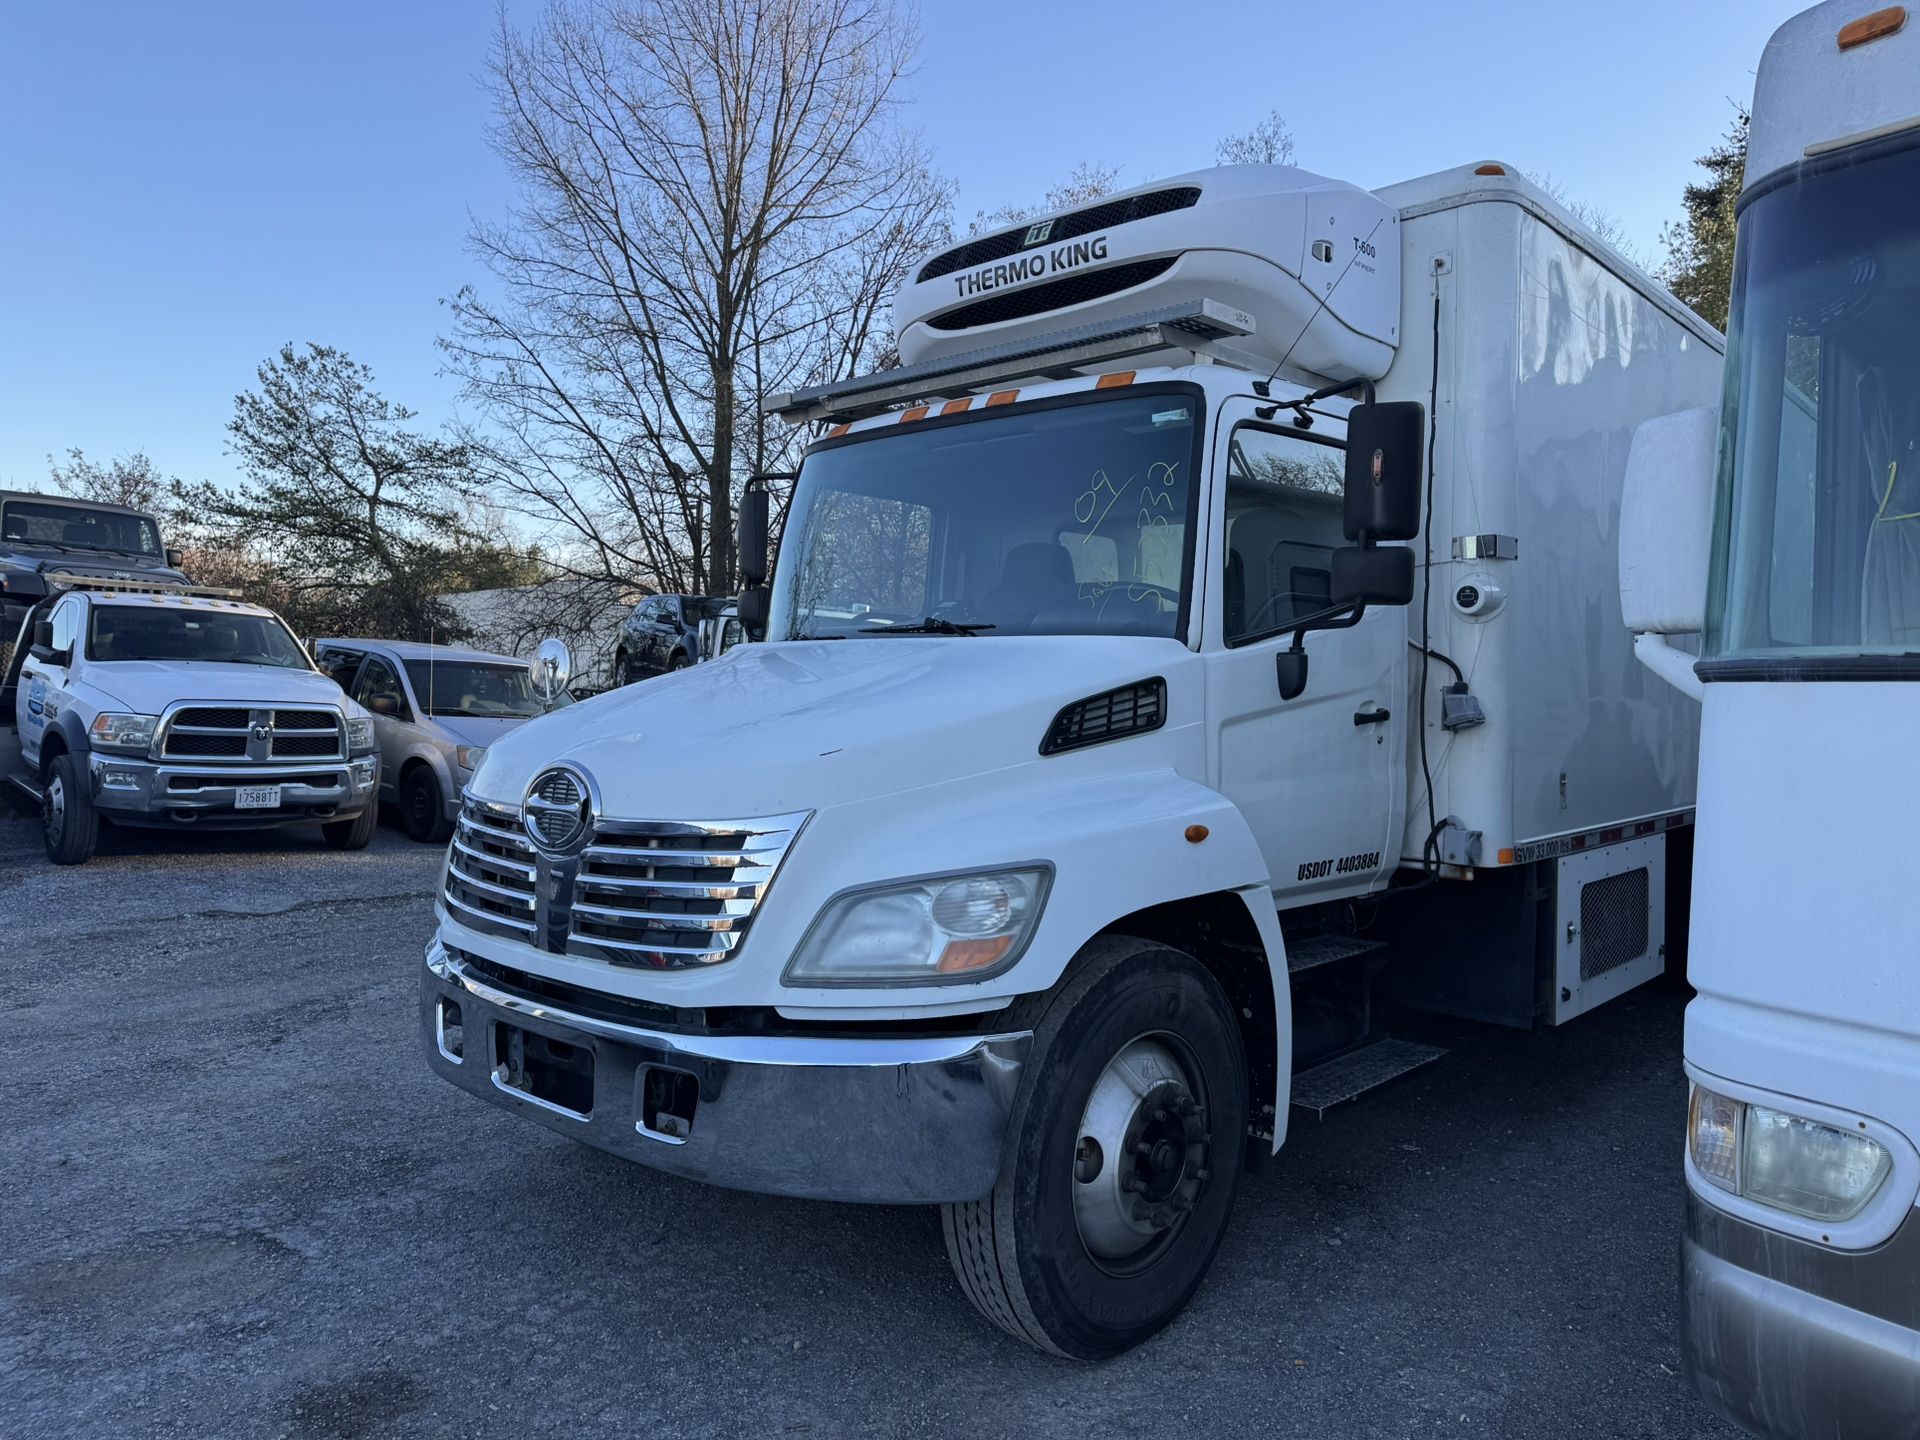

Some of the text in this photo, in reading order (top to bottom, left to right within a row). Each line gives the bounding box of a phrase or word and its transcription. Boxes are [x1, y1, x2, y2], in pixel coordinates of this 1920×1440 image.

[1353, 236, 1376, 259] T-600
[954, 236, 1108, 297] THERMO KING
[1297, 851, 1380, 881] USDOT 4403884
[1515, 844, 1535, 863] GVW
